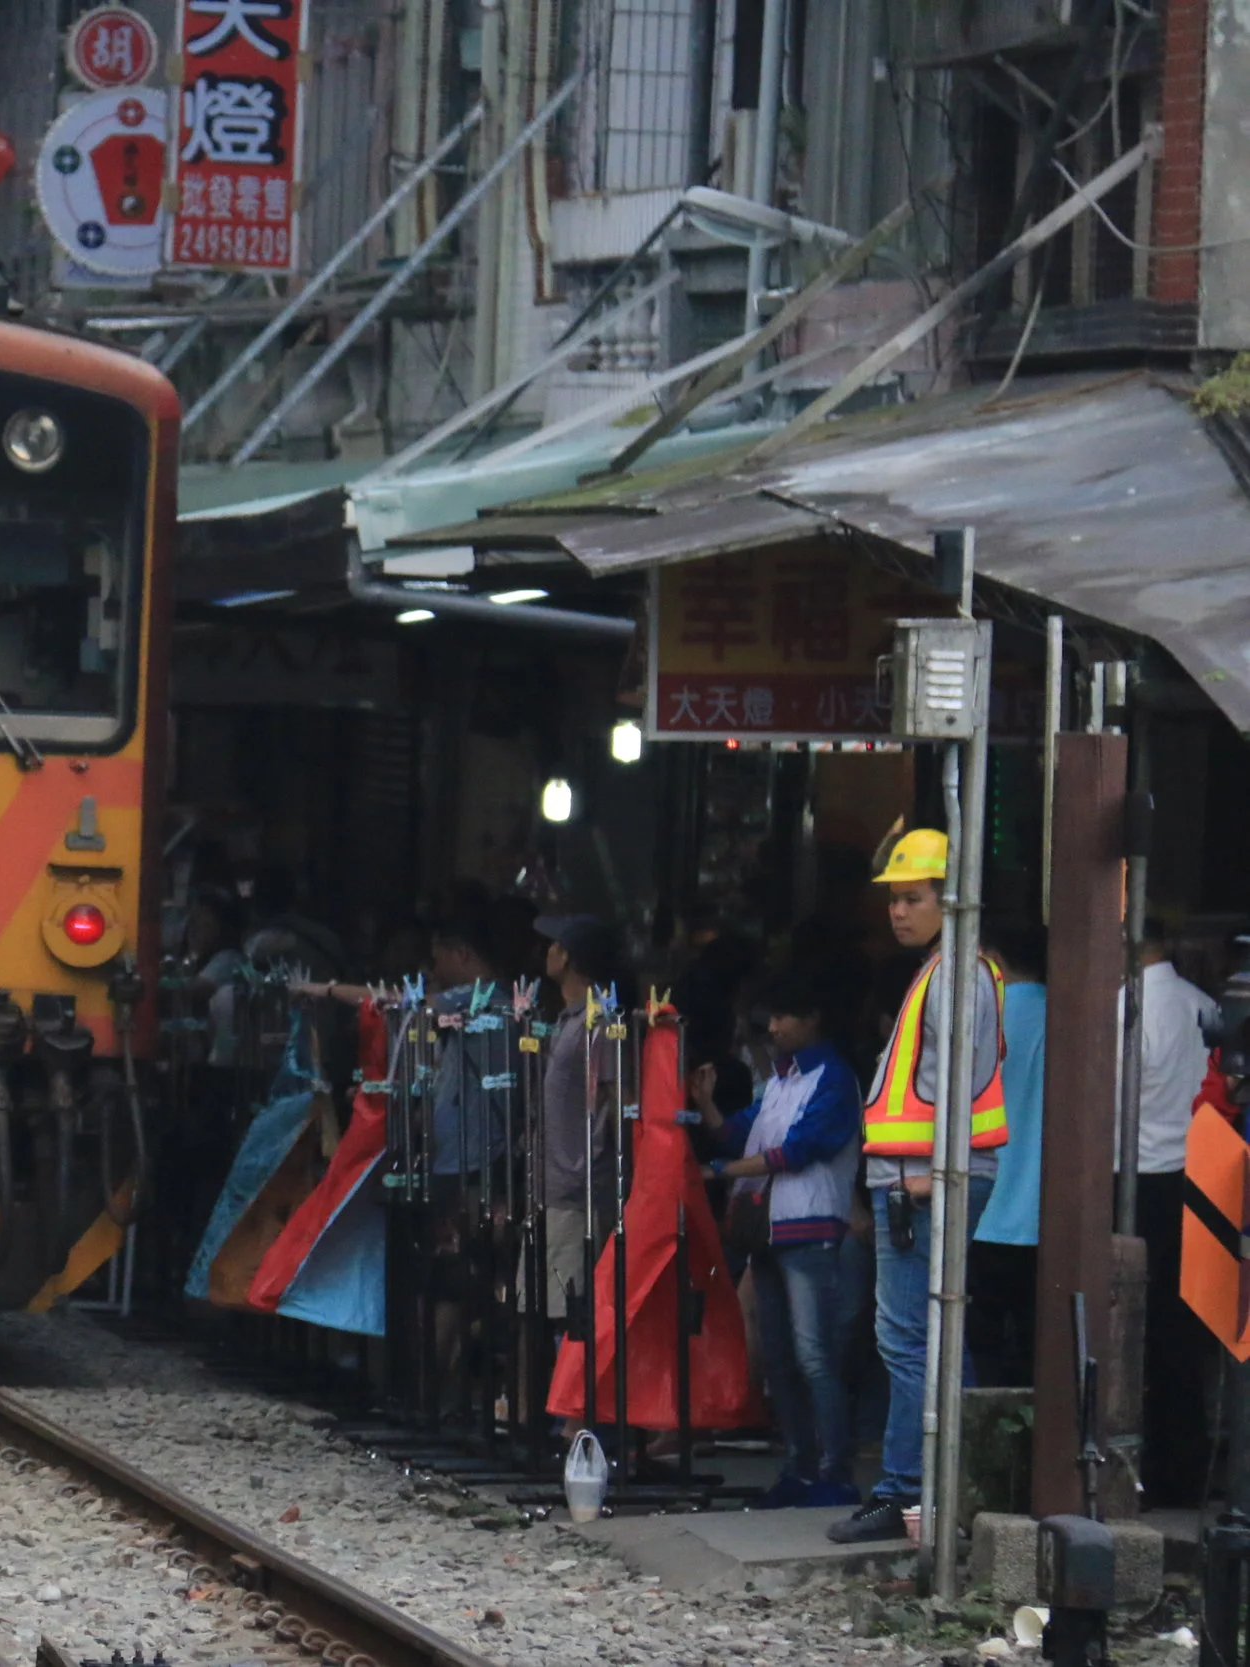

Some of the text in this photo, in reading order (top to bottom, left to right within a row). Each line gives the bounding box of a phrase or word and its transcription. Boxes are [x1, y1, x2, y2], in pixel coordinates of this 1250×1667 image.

[91, 25, 134, 76] 胡
[181, 173, 288, 220] 批發零售
[180, 223, 289, 263] 24958209
